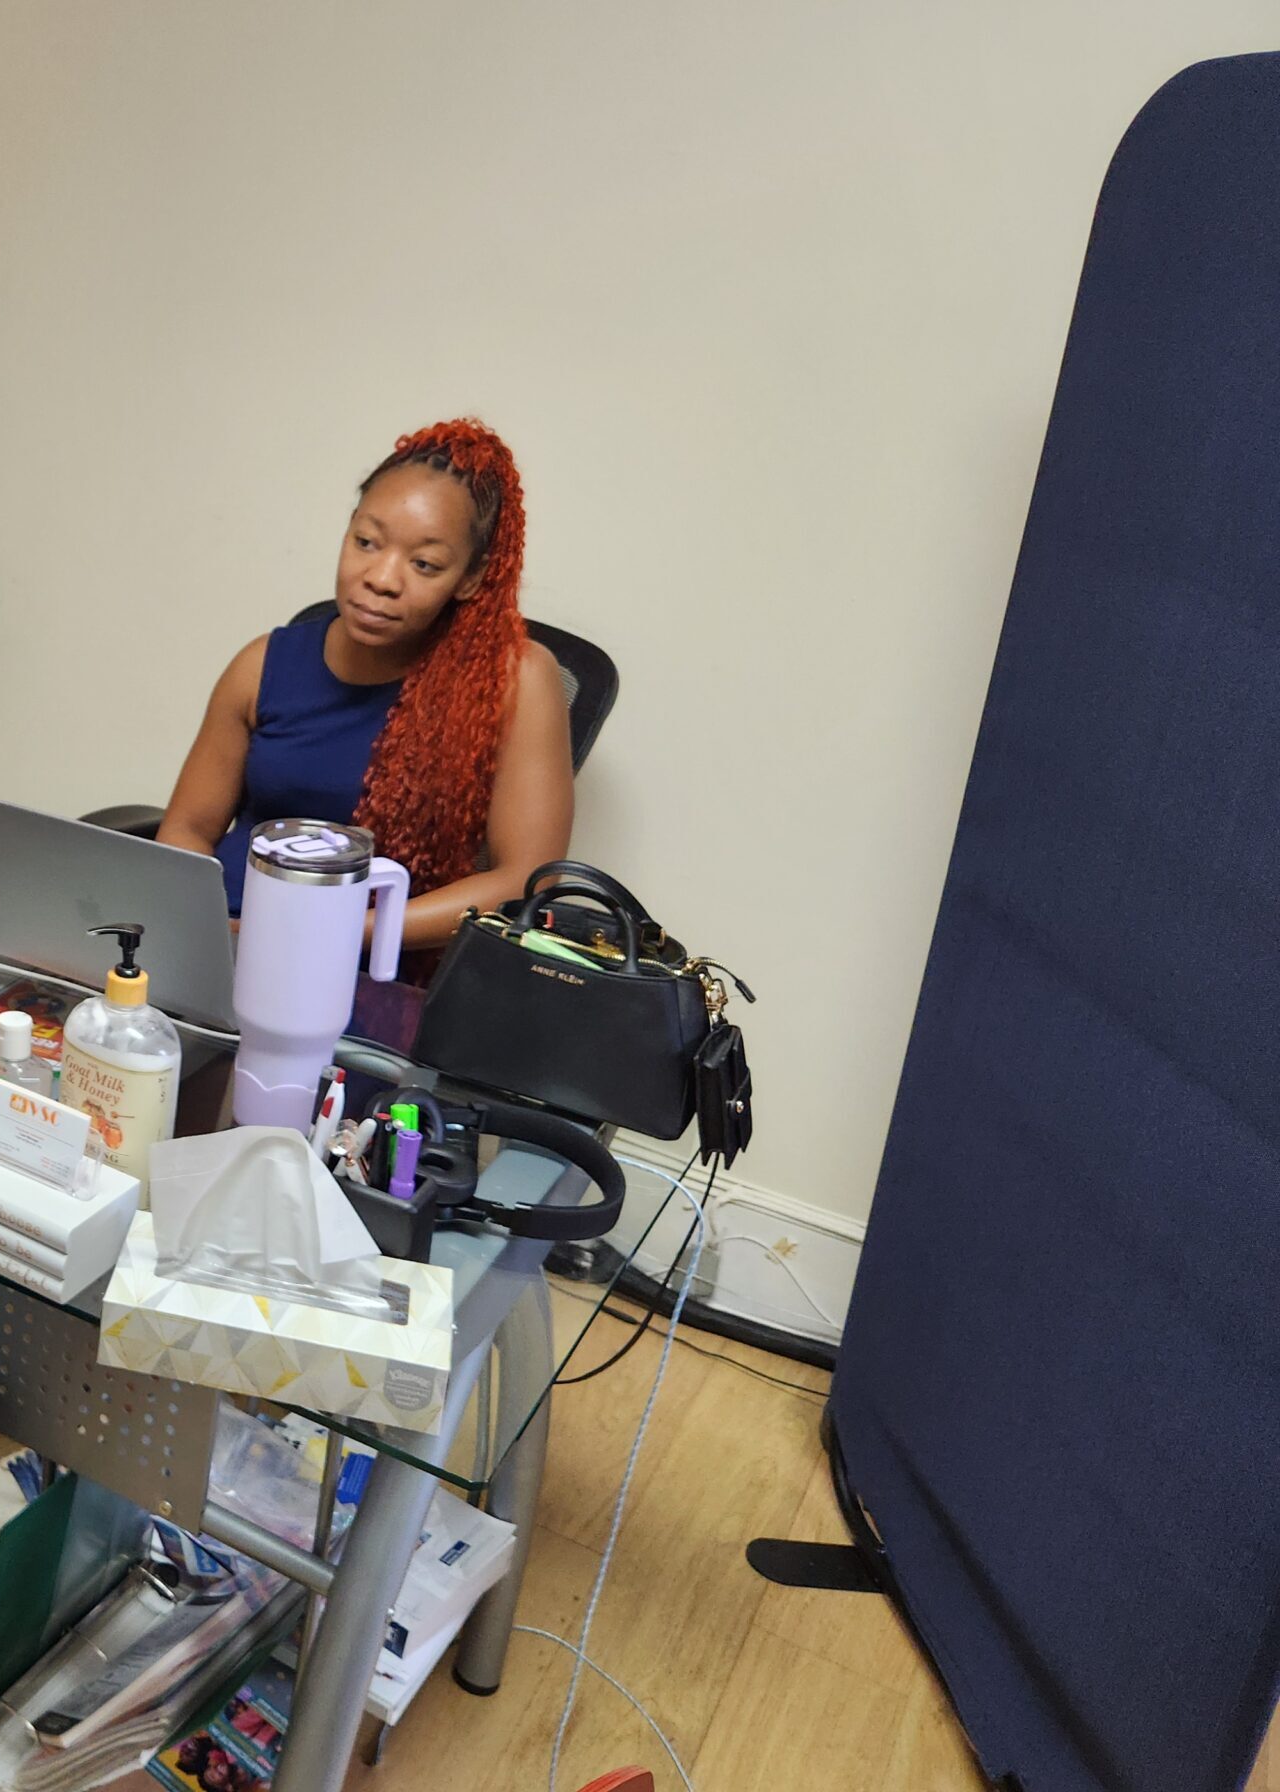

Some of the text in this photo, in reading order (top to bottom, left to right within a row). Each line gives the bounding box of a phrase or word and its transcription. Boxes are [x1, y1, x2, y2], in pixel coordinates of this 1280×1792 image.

[530, 964, 586, 986] ANNE KLEIN
[65, 1054, 126, 1094] Goat Milk
[66, 1070, 122, 1107] & Honey
